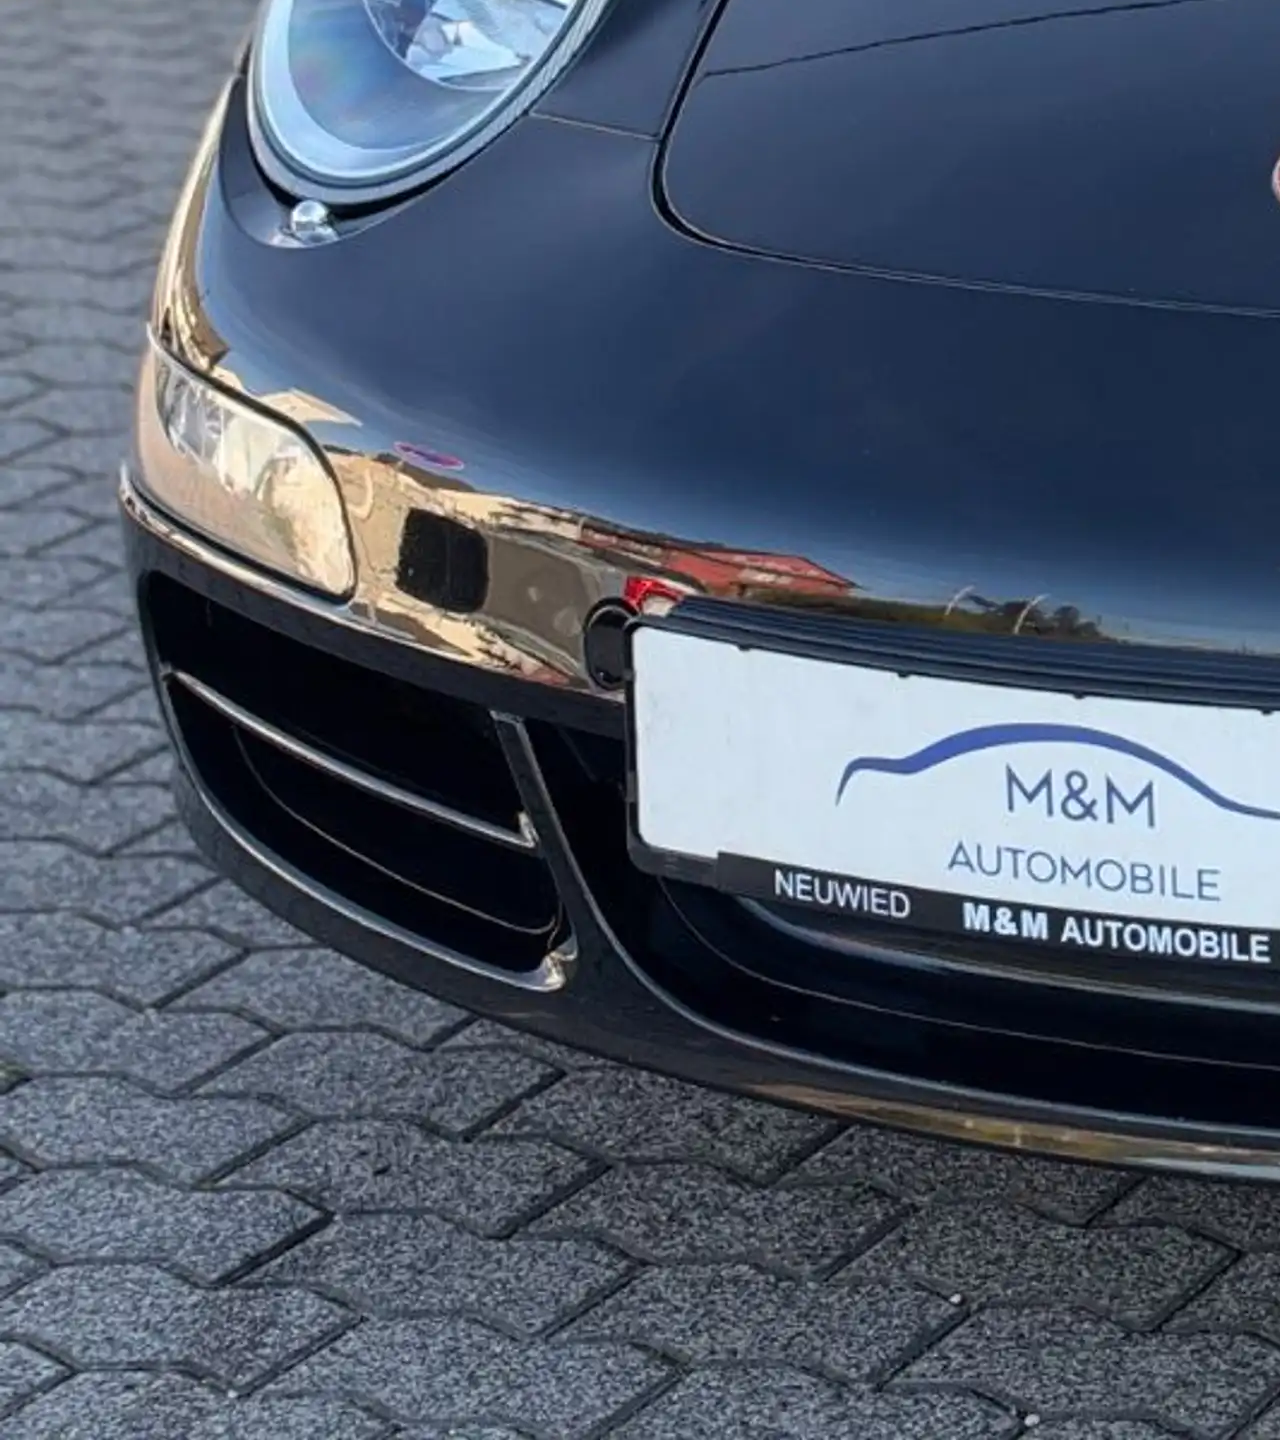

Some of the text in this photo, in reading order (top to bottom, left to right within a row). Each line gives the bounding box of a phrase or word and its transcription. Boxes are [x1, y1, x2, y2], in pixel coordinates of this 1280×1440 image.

[1007, 766, 1155, 829] M&M
[948, 841, 1221, 902] AUTOMOBILE
[774, 868, 911, 919] NEUWIED
[963, 901, 1048, 941] M&M
[1061, 914, 1271, 964] AUTOMOBILE
